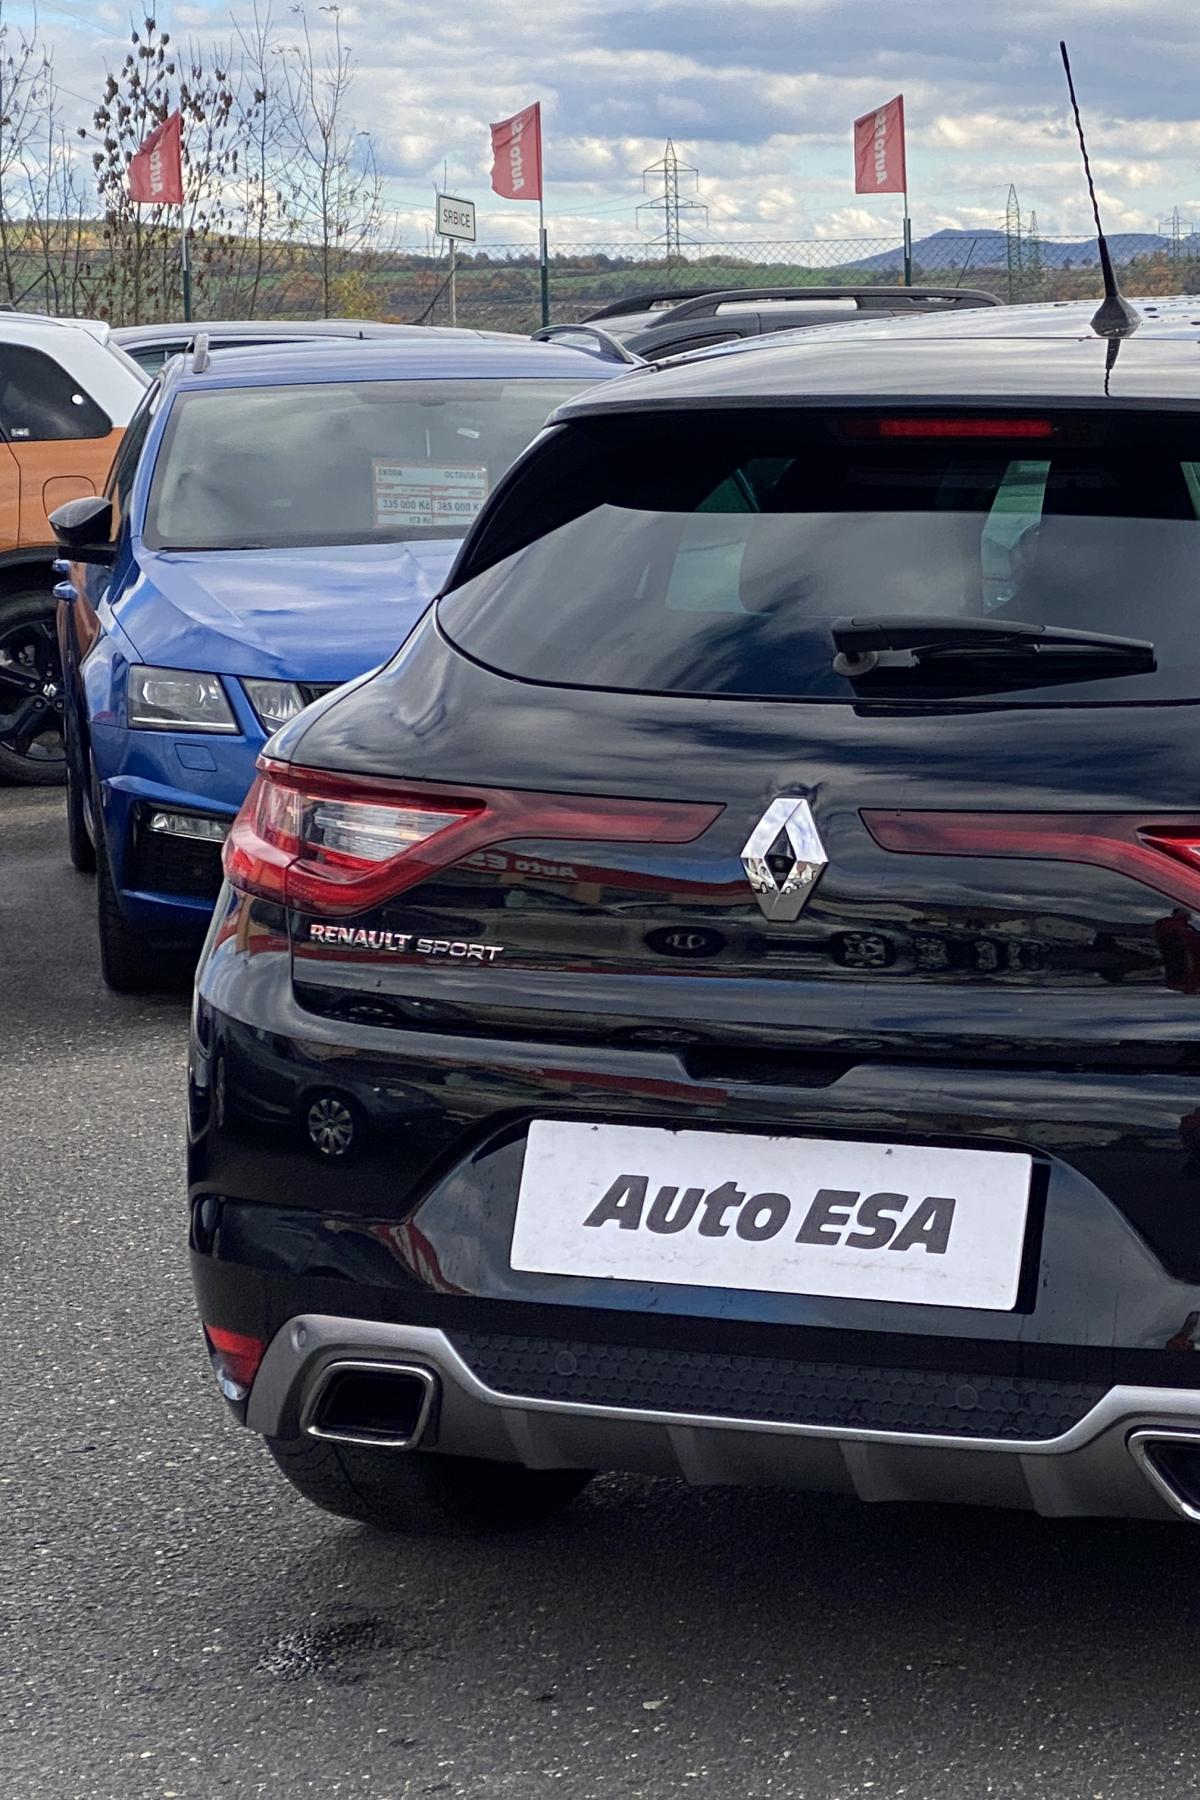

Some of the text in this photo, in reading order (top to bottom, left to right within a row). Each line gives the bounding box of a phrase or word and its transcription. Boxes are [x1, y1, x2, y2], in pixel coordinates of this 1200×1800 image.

[443, 208, 471, 228] SRBICE
[310, 924, 504, 961] RENAULT SPORT
[582, 1174, 956, 1255] Auto ESA
